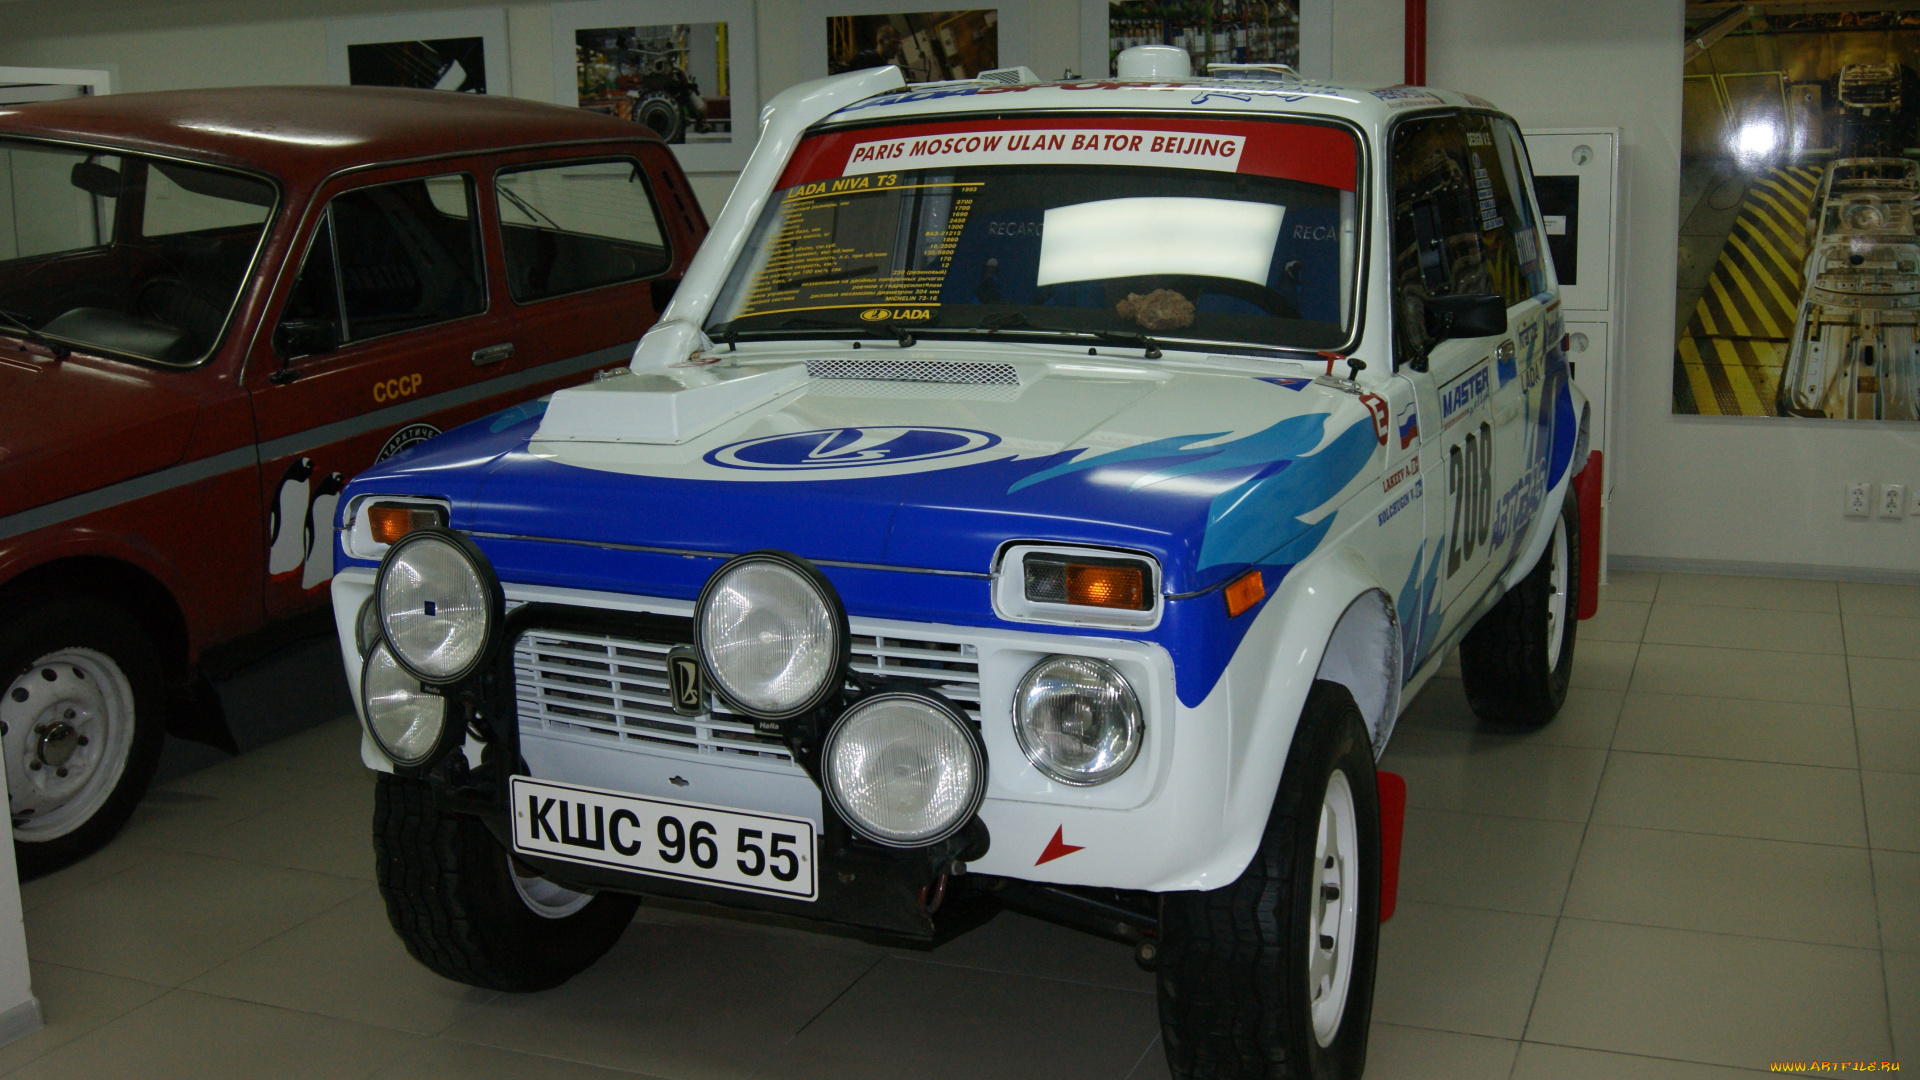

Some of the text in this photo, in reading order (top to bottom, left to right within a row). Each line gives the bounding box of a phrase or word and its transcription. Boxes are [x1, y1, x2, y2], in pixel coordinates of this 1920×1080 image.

[852, 134, 1236, 163] PARIS MOSCOW ULAN BATOR BEIJING
[787, 174, 897, 199] LADA NIVA T3
[892, 309, 930, 320] LADA
[373, 373, 422, 403] СССР
[1443, 366, 1489, 418] MASTER
[1382, 468, 1404, 494] LAKEEV
[1447, 421, 1492, 580] 208
[760, 721, 779, 730] Hella
[528, 795, 800, 882] КШС 96 55
